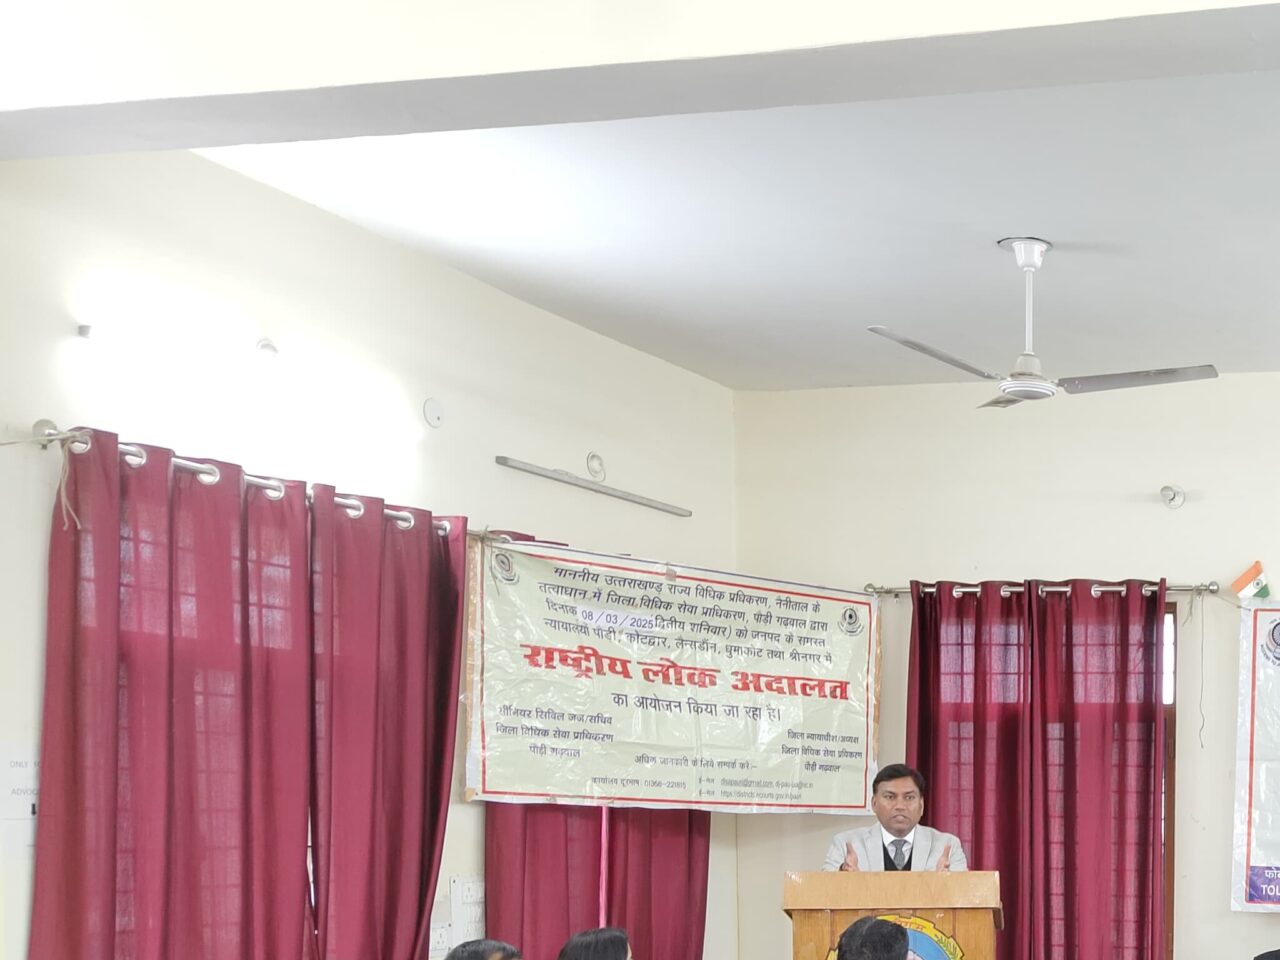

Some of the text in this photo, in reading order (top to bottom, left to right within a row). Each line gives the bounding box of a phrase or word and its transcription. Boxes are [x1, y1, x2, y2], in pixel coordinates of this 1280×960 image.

[554, 567, 599, 583] माननीय
[667, 583, 691, 597] राज्य
[695, 584, 725, 600] विधिक
[812, 601, 820, 614] के
[592, 588, 602, 602] में
[606, 590, 636, 608] जिला
[639, 595, 673, 611] विधिक
[677, 602, 698, 615] सेवा
[809, 620, 828, 632] द्वारा
[735, 626, 748, 639] को
[751, 630, 780, 642] जनपद
[782, 632, 794, 644] के
[766, 649, 785, 660] तथा
[790, 648, 821, 663] श्रीनगर
[519, 644, 850, 700] राष्ट्रीय लोक अदालत
[535, 707, 565, 721] सिविल
[611, 692, 628, 708] का
[633, 693, 682, 714] आयोजन
[686, 696, 718, 717] किया
[722, 704, 739, 718] जा
[744, 706, 762, 721] रहा
[495, 722, 518, 736] जिला
[521, 725, 550, 737] विधिक
[553, 727, 570, 739] सेवा
[787, 729, 805, 740] जिला
[781, 744, 799, 755] जिला
[801, 746, 821, 756] विधिक
[823, 747, 836, 758] सेवा
